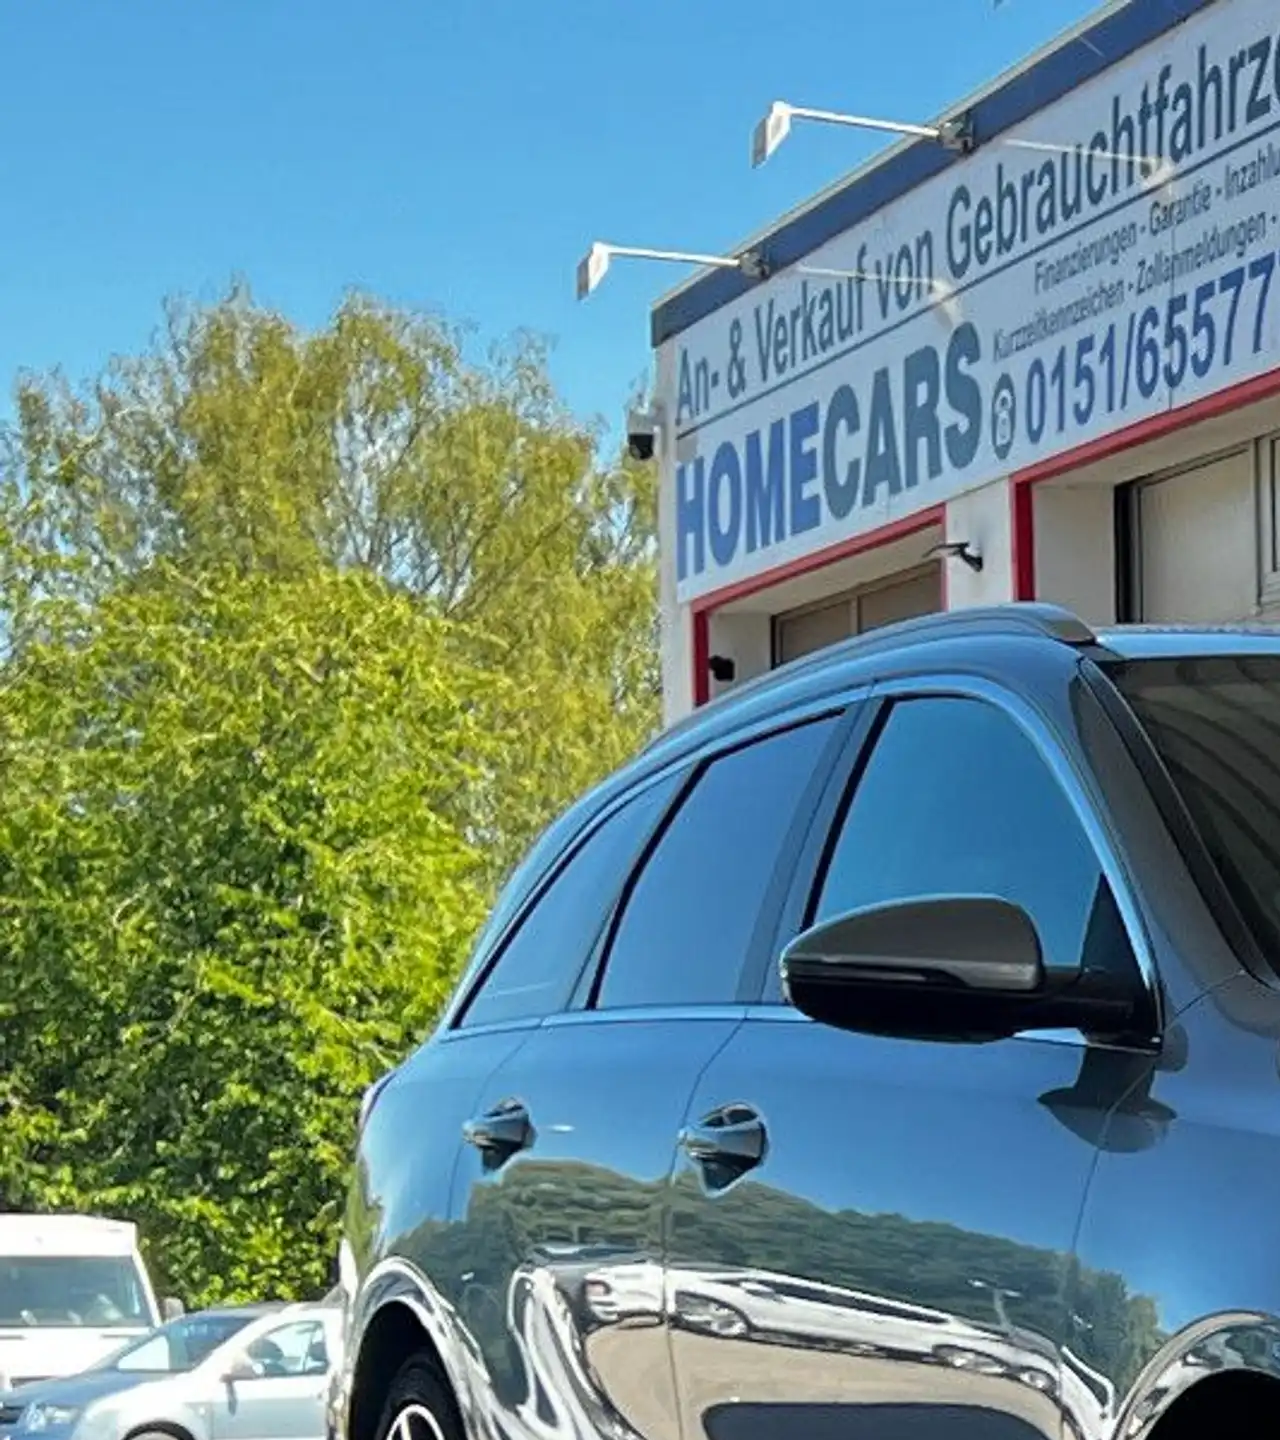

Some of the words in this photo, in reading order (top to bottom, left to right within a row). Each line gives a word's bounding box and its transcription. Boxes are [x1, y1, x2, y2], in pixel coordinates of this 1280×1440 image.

[1035, 221, 1137, 295] Finanzierungen
[1150, 179, 1211, 236] Garantie
[1137, 211, 1266, 295] Zollanmeldungen
[675, 348, 719, 426] An-
[727, 318, 746, 399] &
[754, 242, 868, 382] Verkauf
[875, 230, 933, 319] von
[676, 321, 982, 582] HOMECARS
